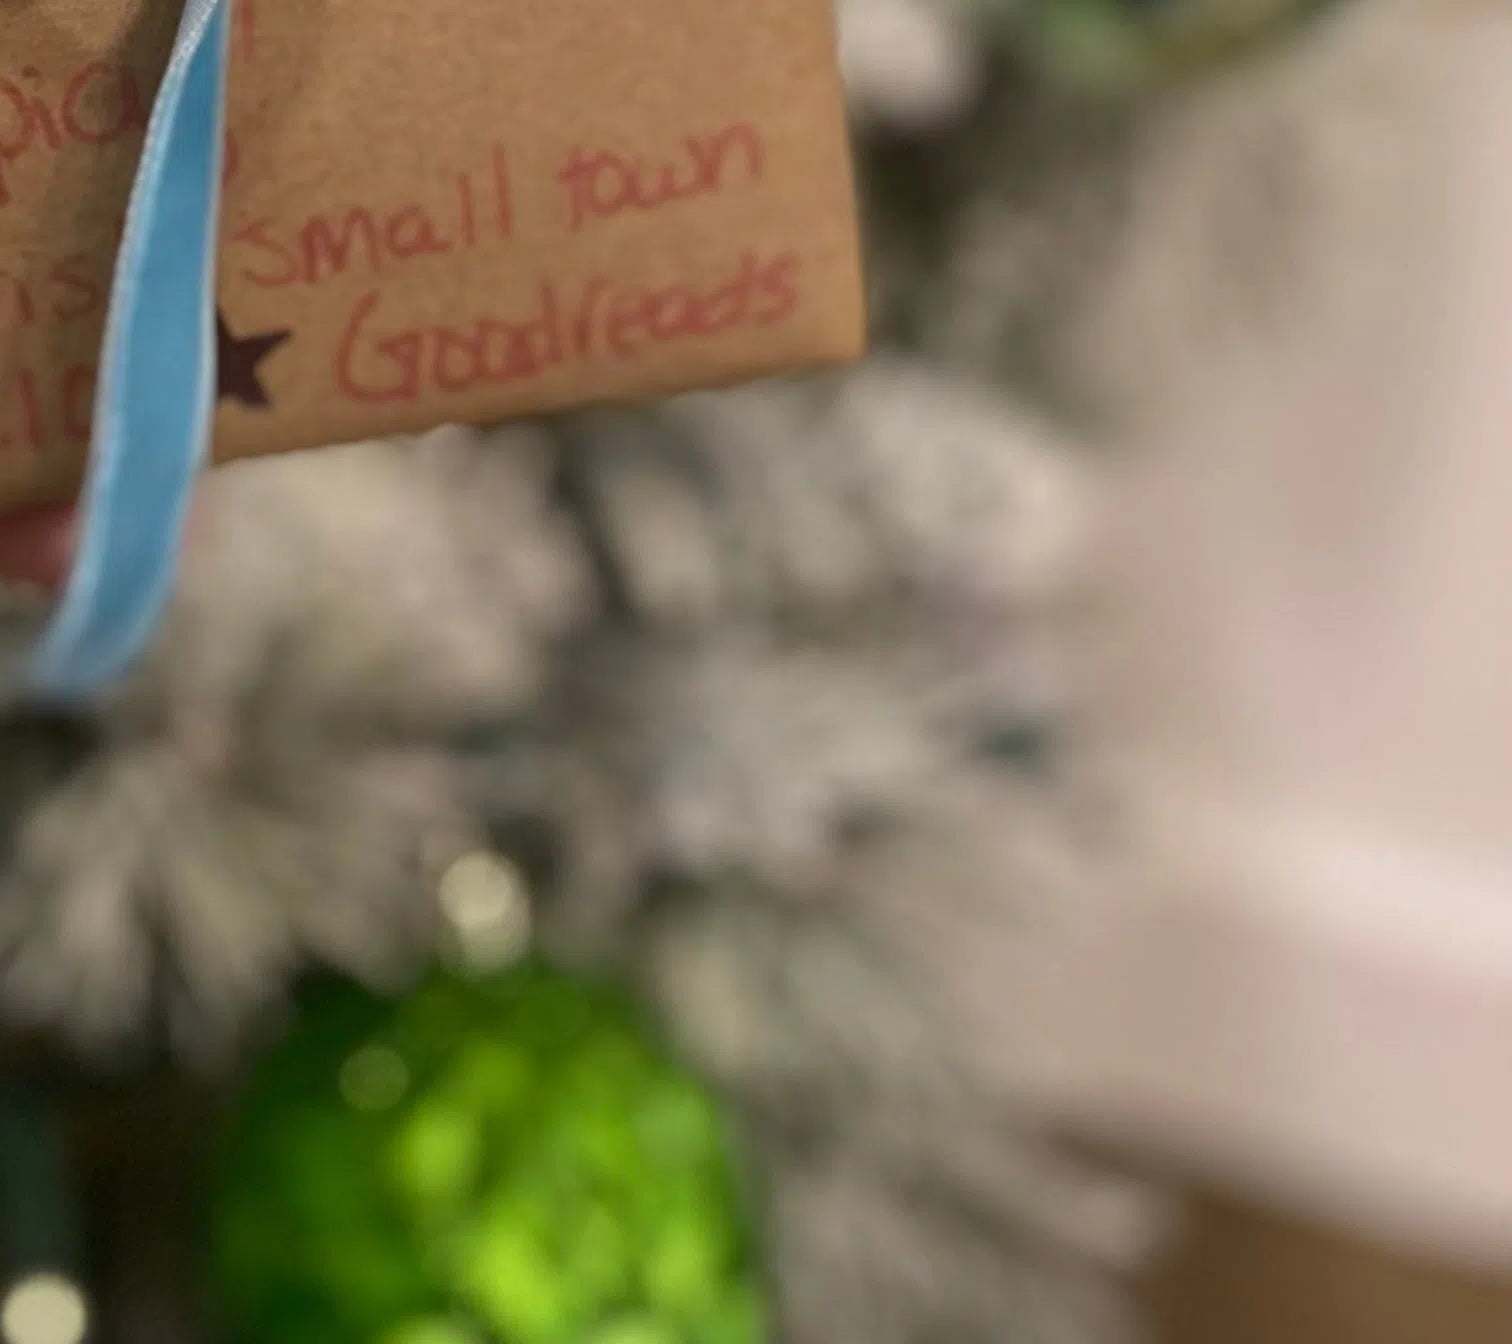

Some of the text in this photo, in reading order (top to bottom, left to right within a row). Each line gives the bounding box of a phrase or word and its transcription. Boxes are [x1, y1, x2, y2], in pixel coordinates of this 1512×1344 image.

[233, 142, 511, 288] small
[558, 122, 765, 232] town
[333, 248, 800, 404] Goodreads
